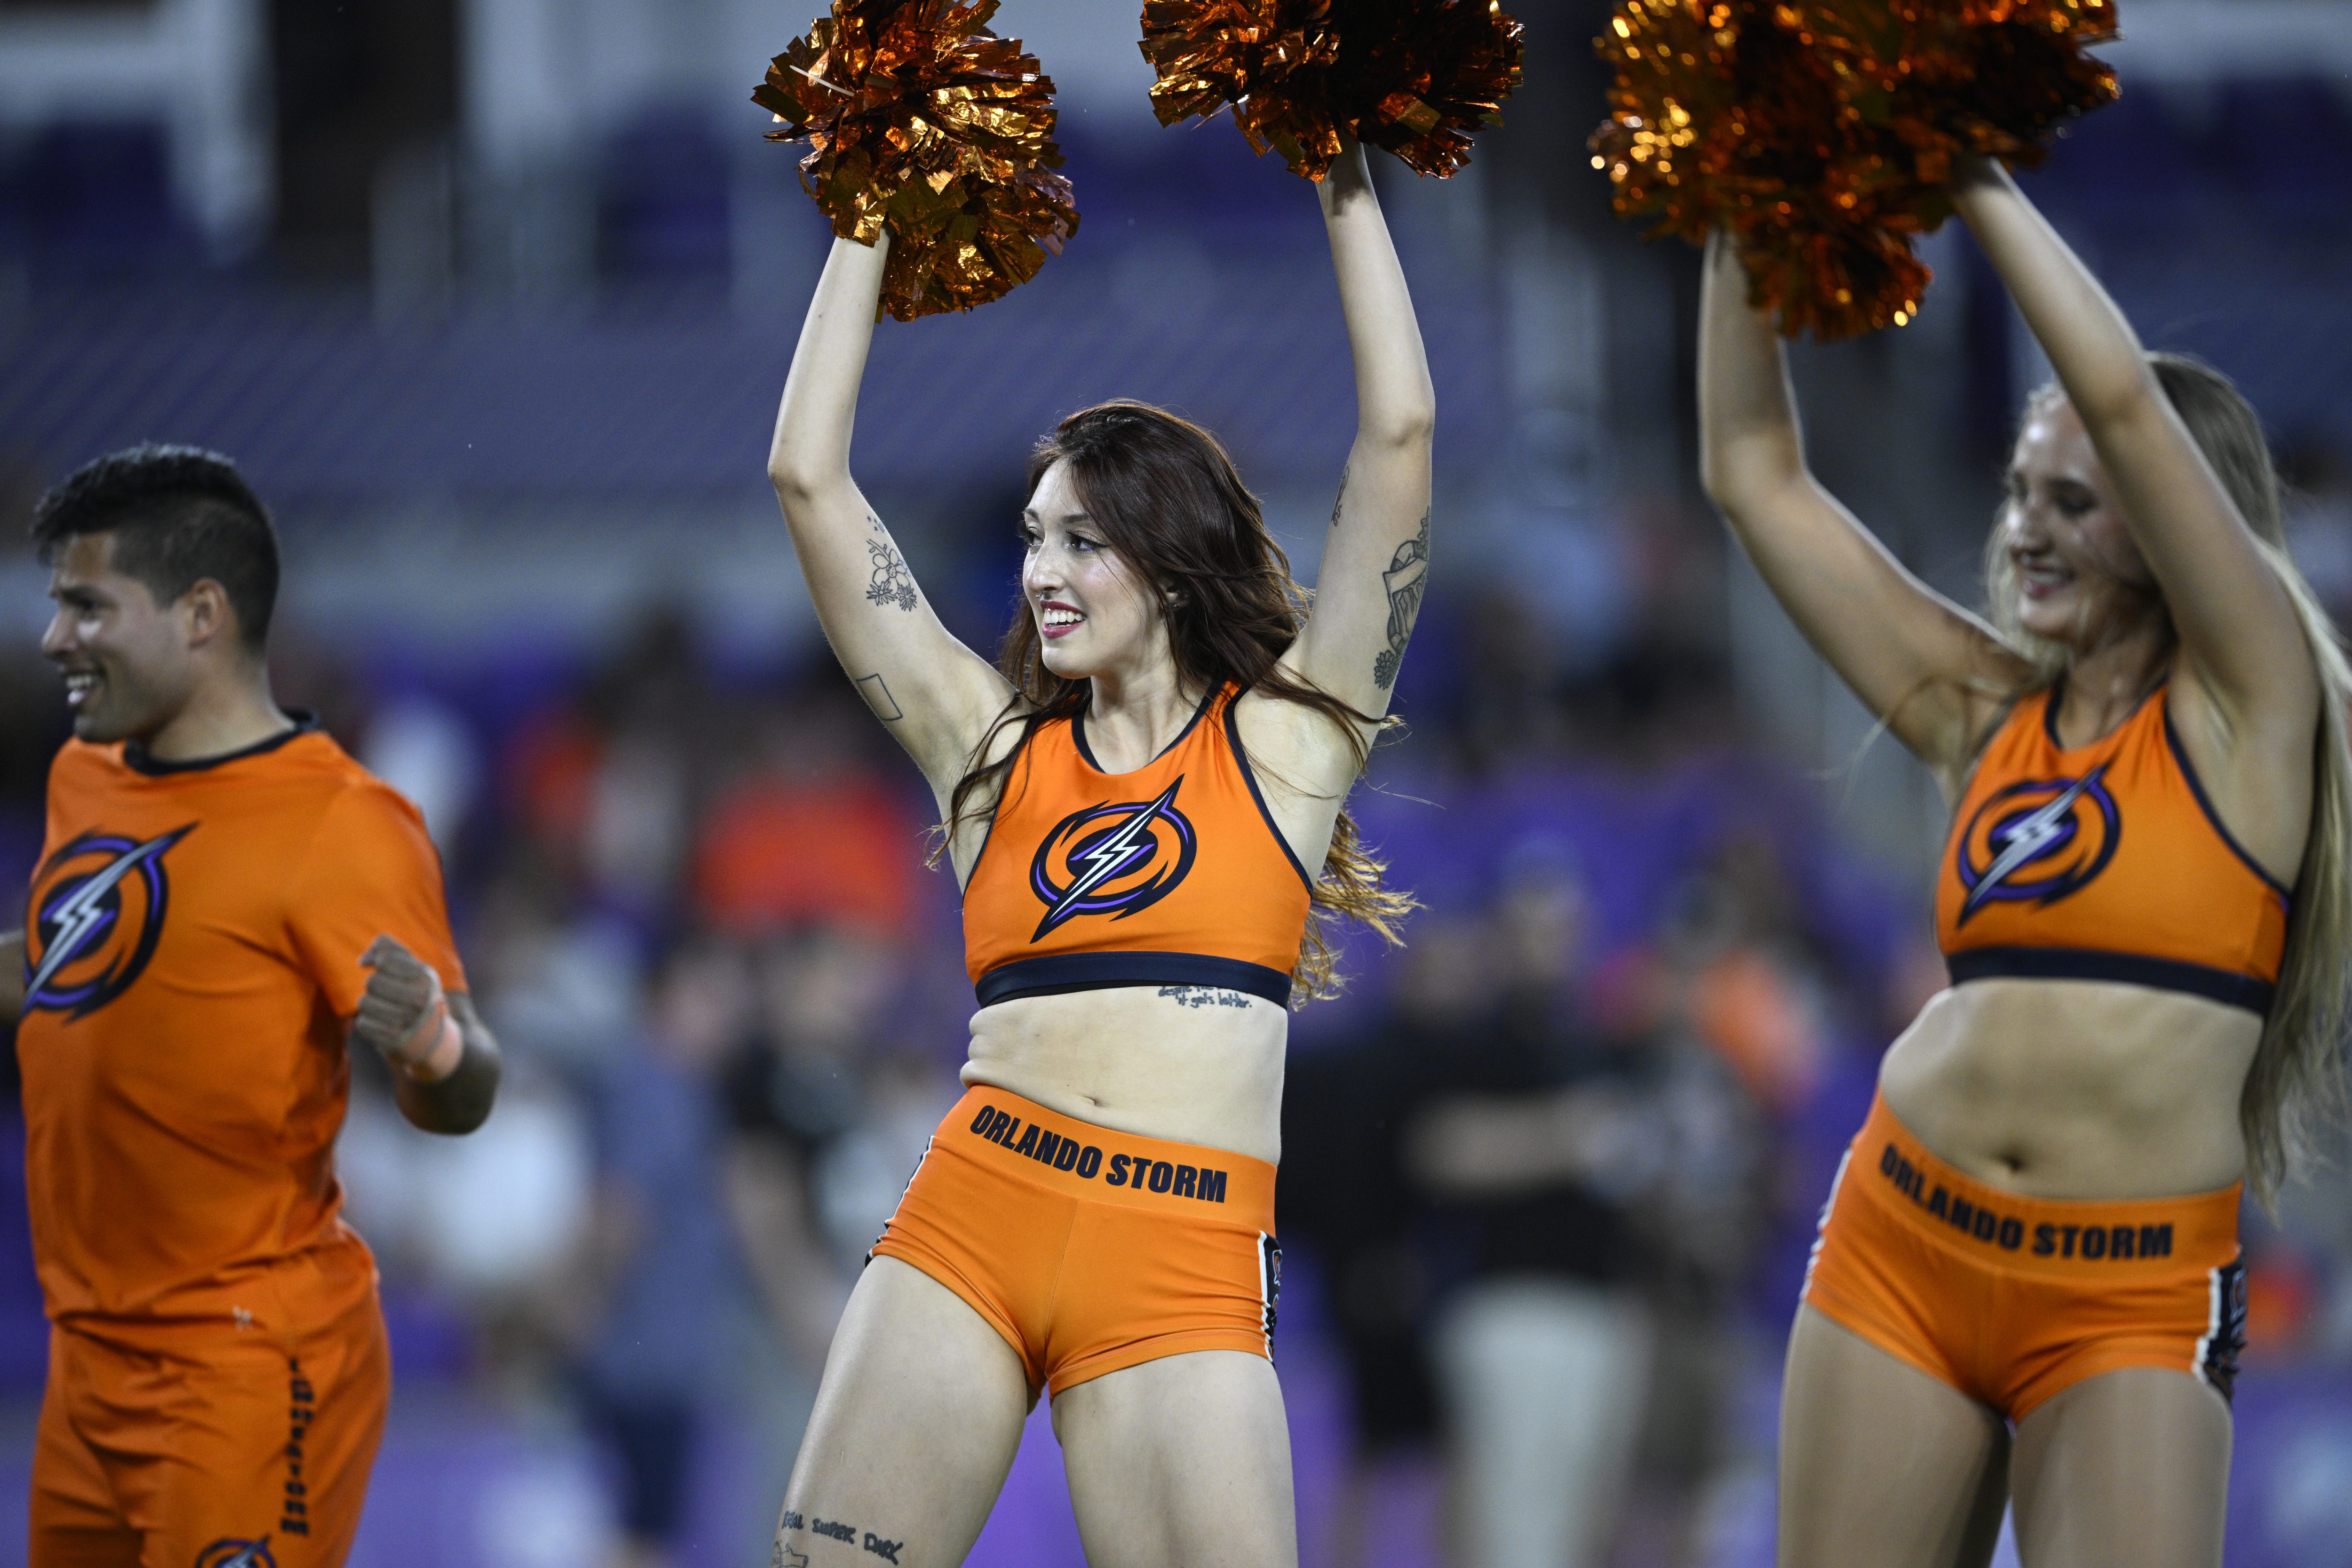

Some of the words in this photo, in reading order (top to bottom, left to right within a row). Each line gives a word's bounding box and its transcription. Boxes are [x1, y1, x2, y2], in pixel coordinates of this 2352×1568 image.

[1191, 992, 1215, 1008] gets
[969, 1105, 1103, 1179] ORLANDO
[1105, 1154, 1227, 1203] STORM
[1881, 1144, 2024, 1250] ORLANDO
[2032, 1222, 2173, 1260] STORM
